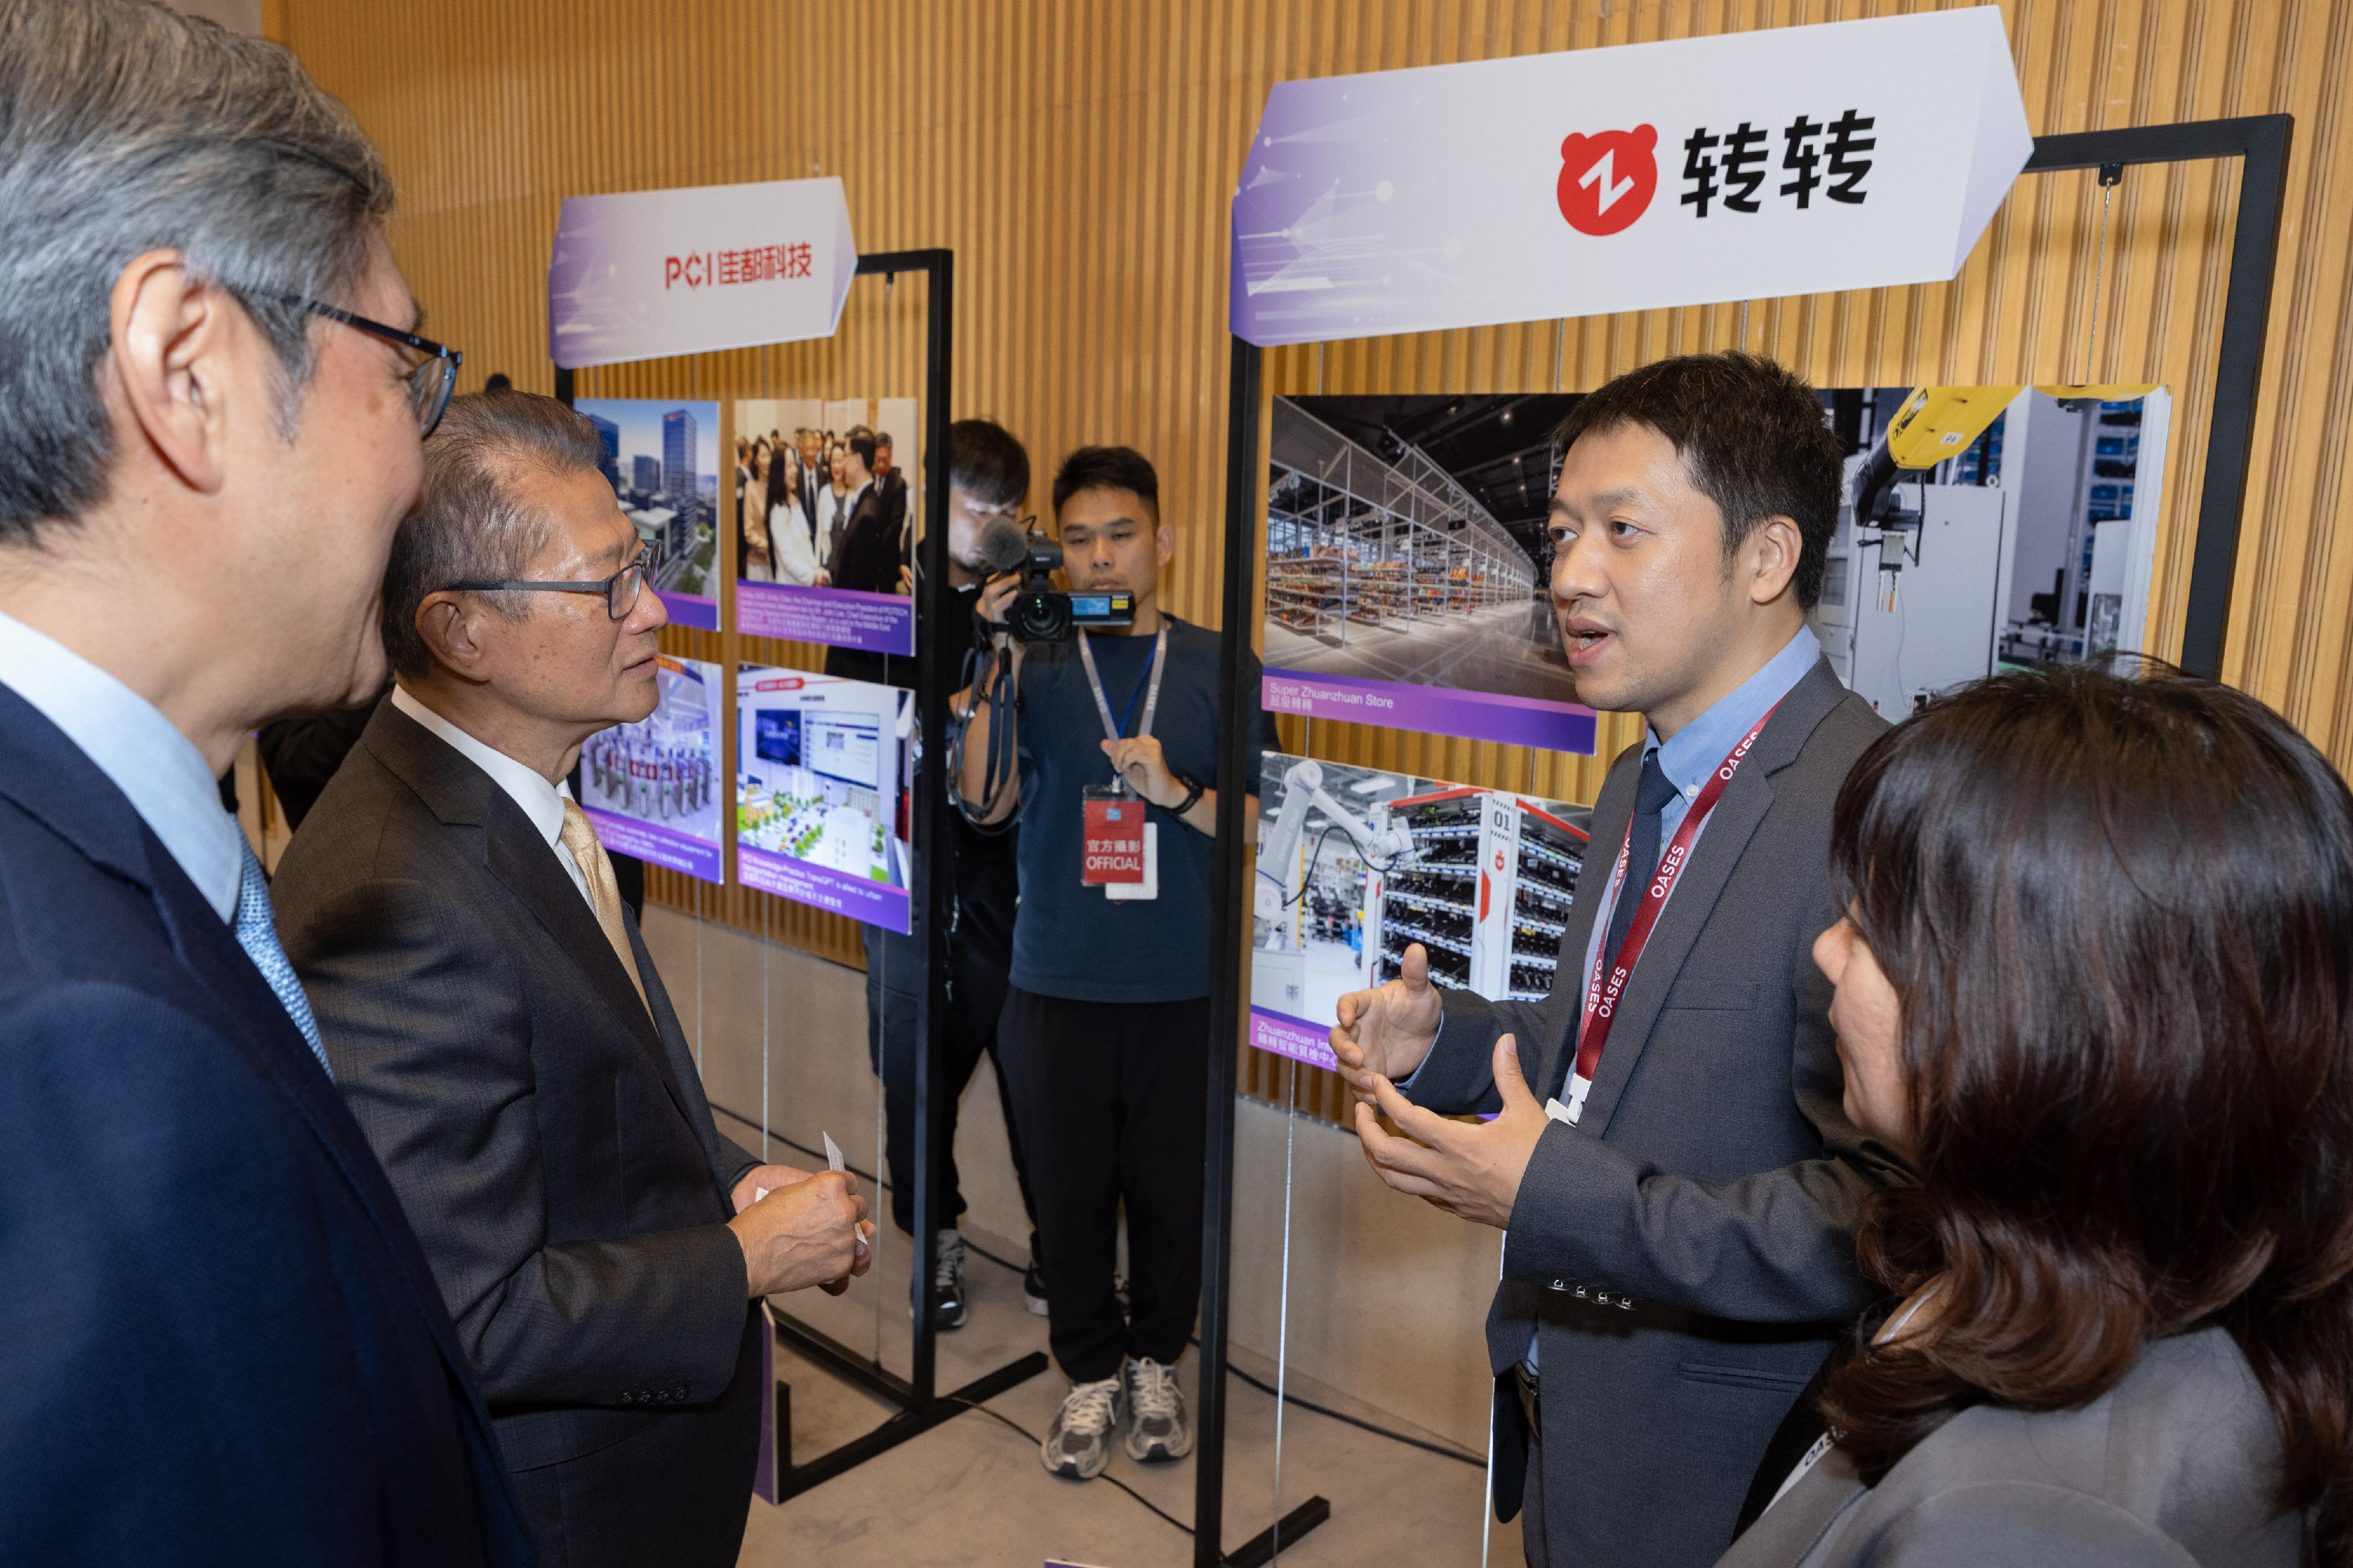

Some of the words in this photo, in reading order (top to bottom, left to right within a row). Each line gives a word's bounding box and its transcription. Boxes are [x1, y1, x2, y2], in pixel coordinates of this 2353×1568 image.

[1681, 109, 1877, 218] 转转
[717, 241, 812, 285] 佳都科技
[1270, 682, 1299, 696] Super
[1301, 685, 1362, 705] Zhuanzhuan
[1365, 694, 1394, 709] Store
[1494, 810, 1510, 831] 01
[1086, 856, 1141, 871] OFFICIAL
[1651, 845, 1684, 898] OASES
[1588, 959, 1602, 1012] OASES
[1598, 966, 1627, 1017] OASES
[1257, 1020, 1315, 1047] Zhuanzhuan
